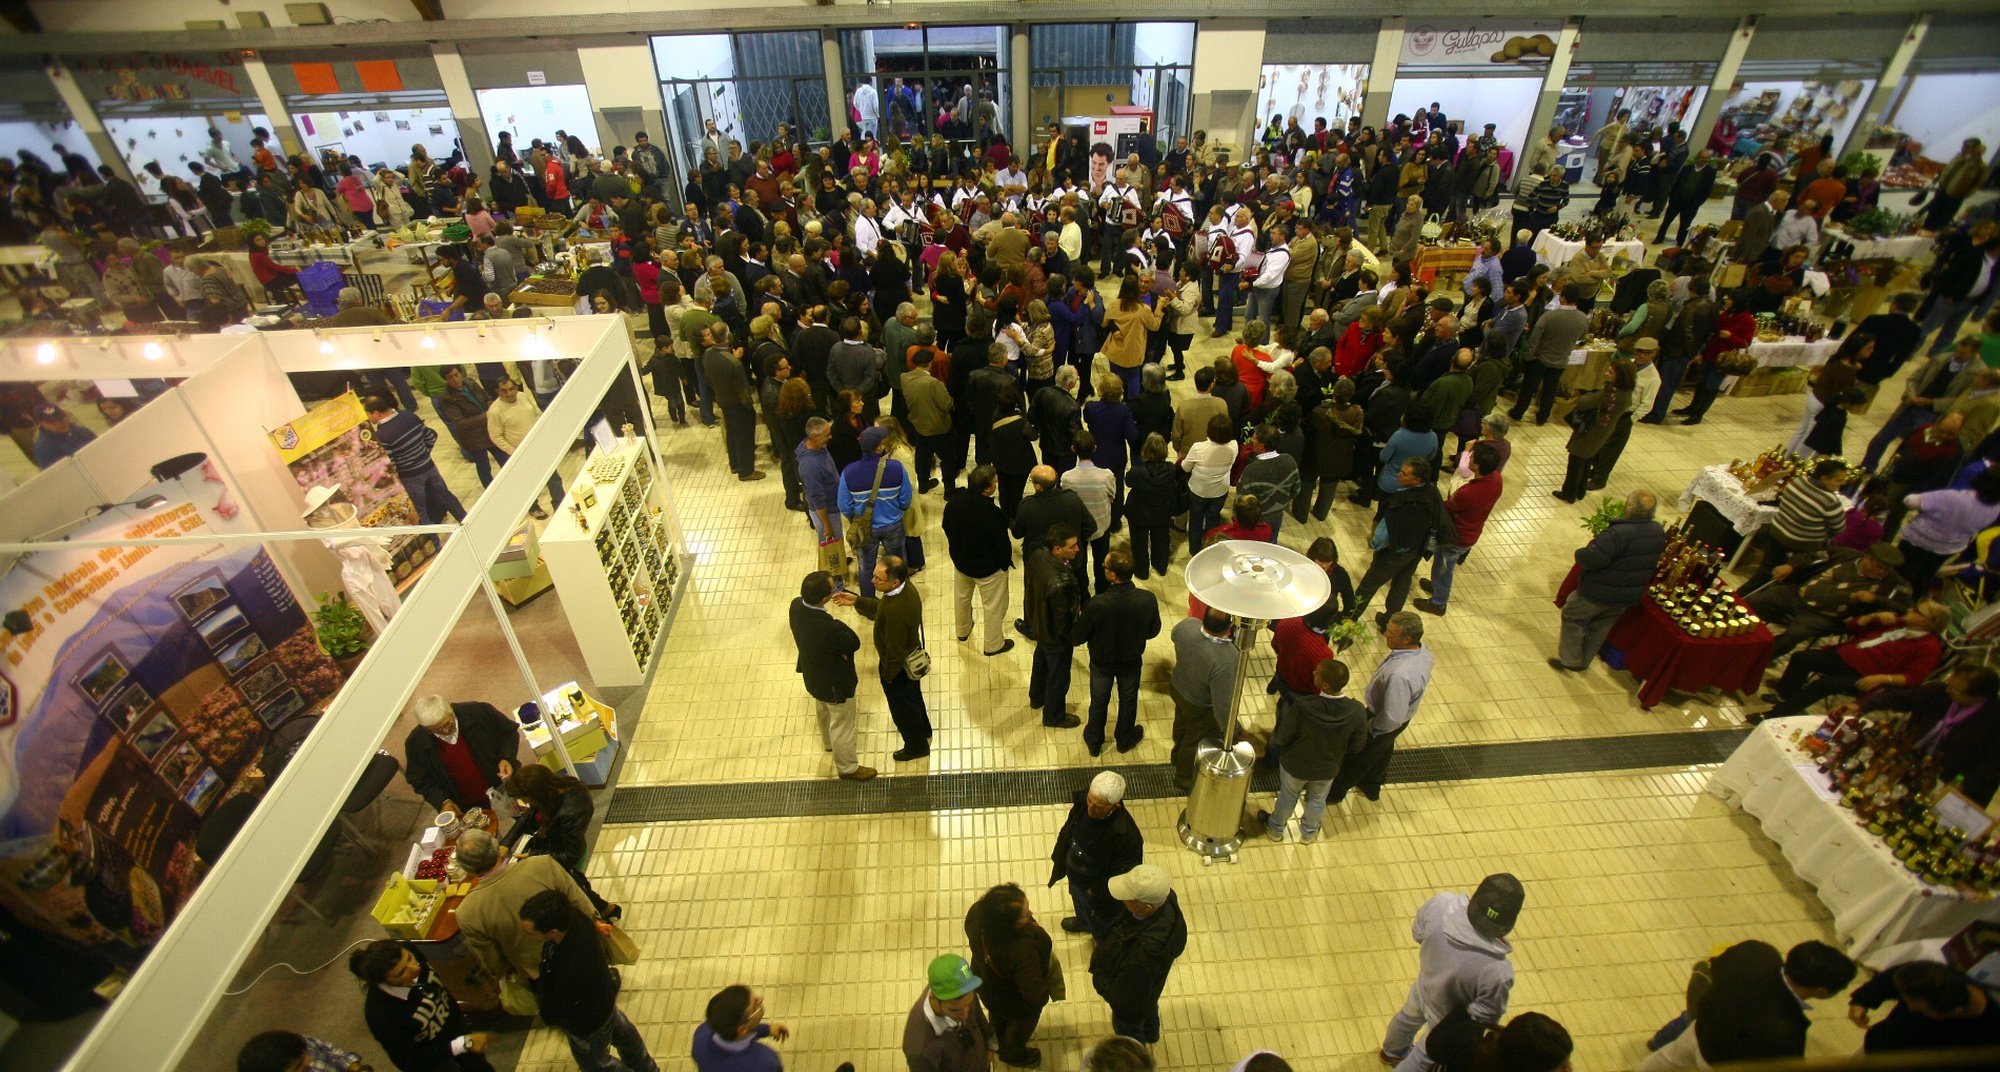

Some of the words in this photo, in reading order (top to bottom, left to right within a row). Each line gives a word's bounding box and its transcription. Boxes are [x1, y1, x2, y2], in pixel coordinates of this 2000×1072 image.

[1441, 27, 1505, 55] Gulapa
[164, 53, 241, 94] MARVEL
[43, 559, 99, 600] Agrícola
[53, 566, 120, 615] Concelhos
